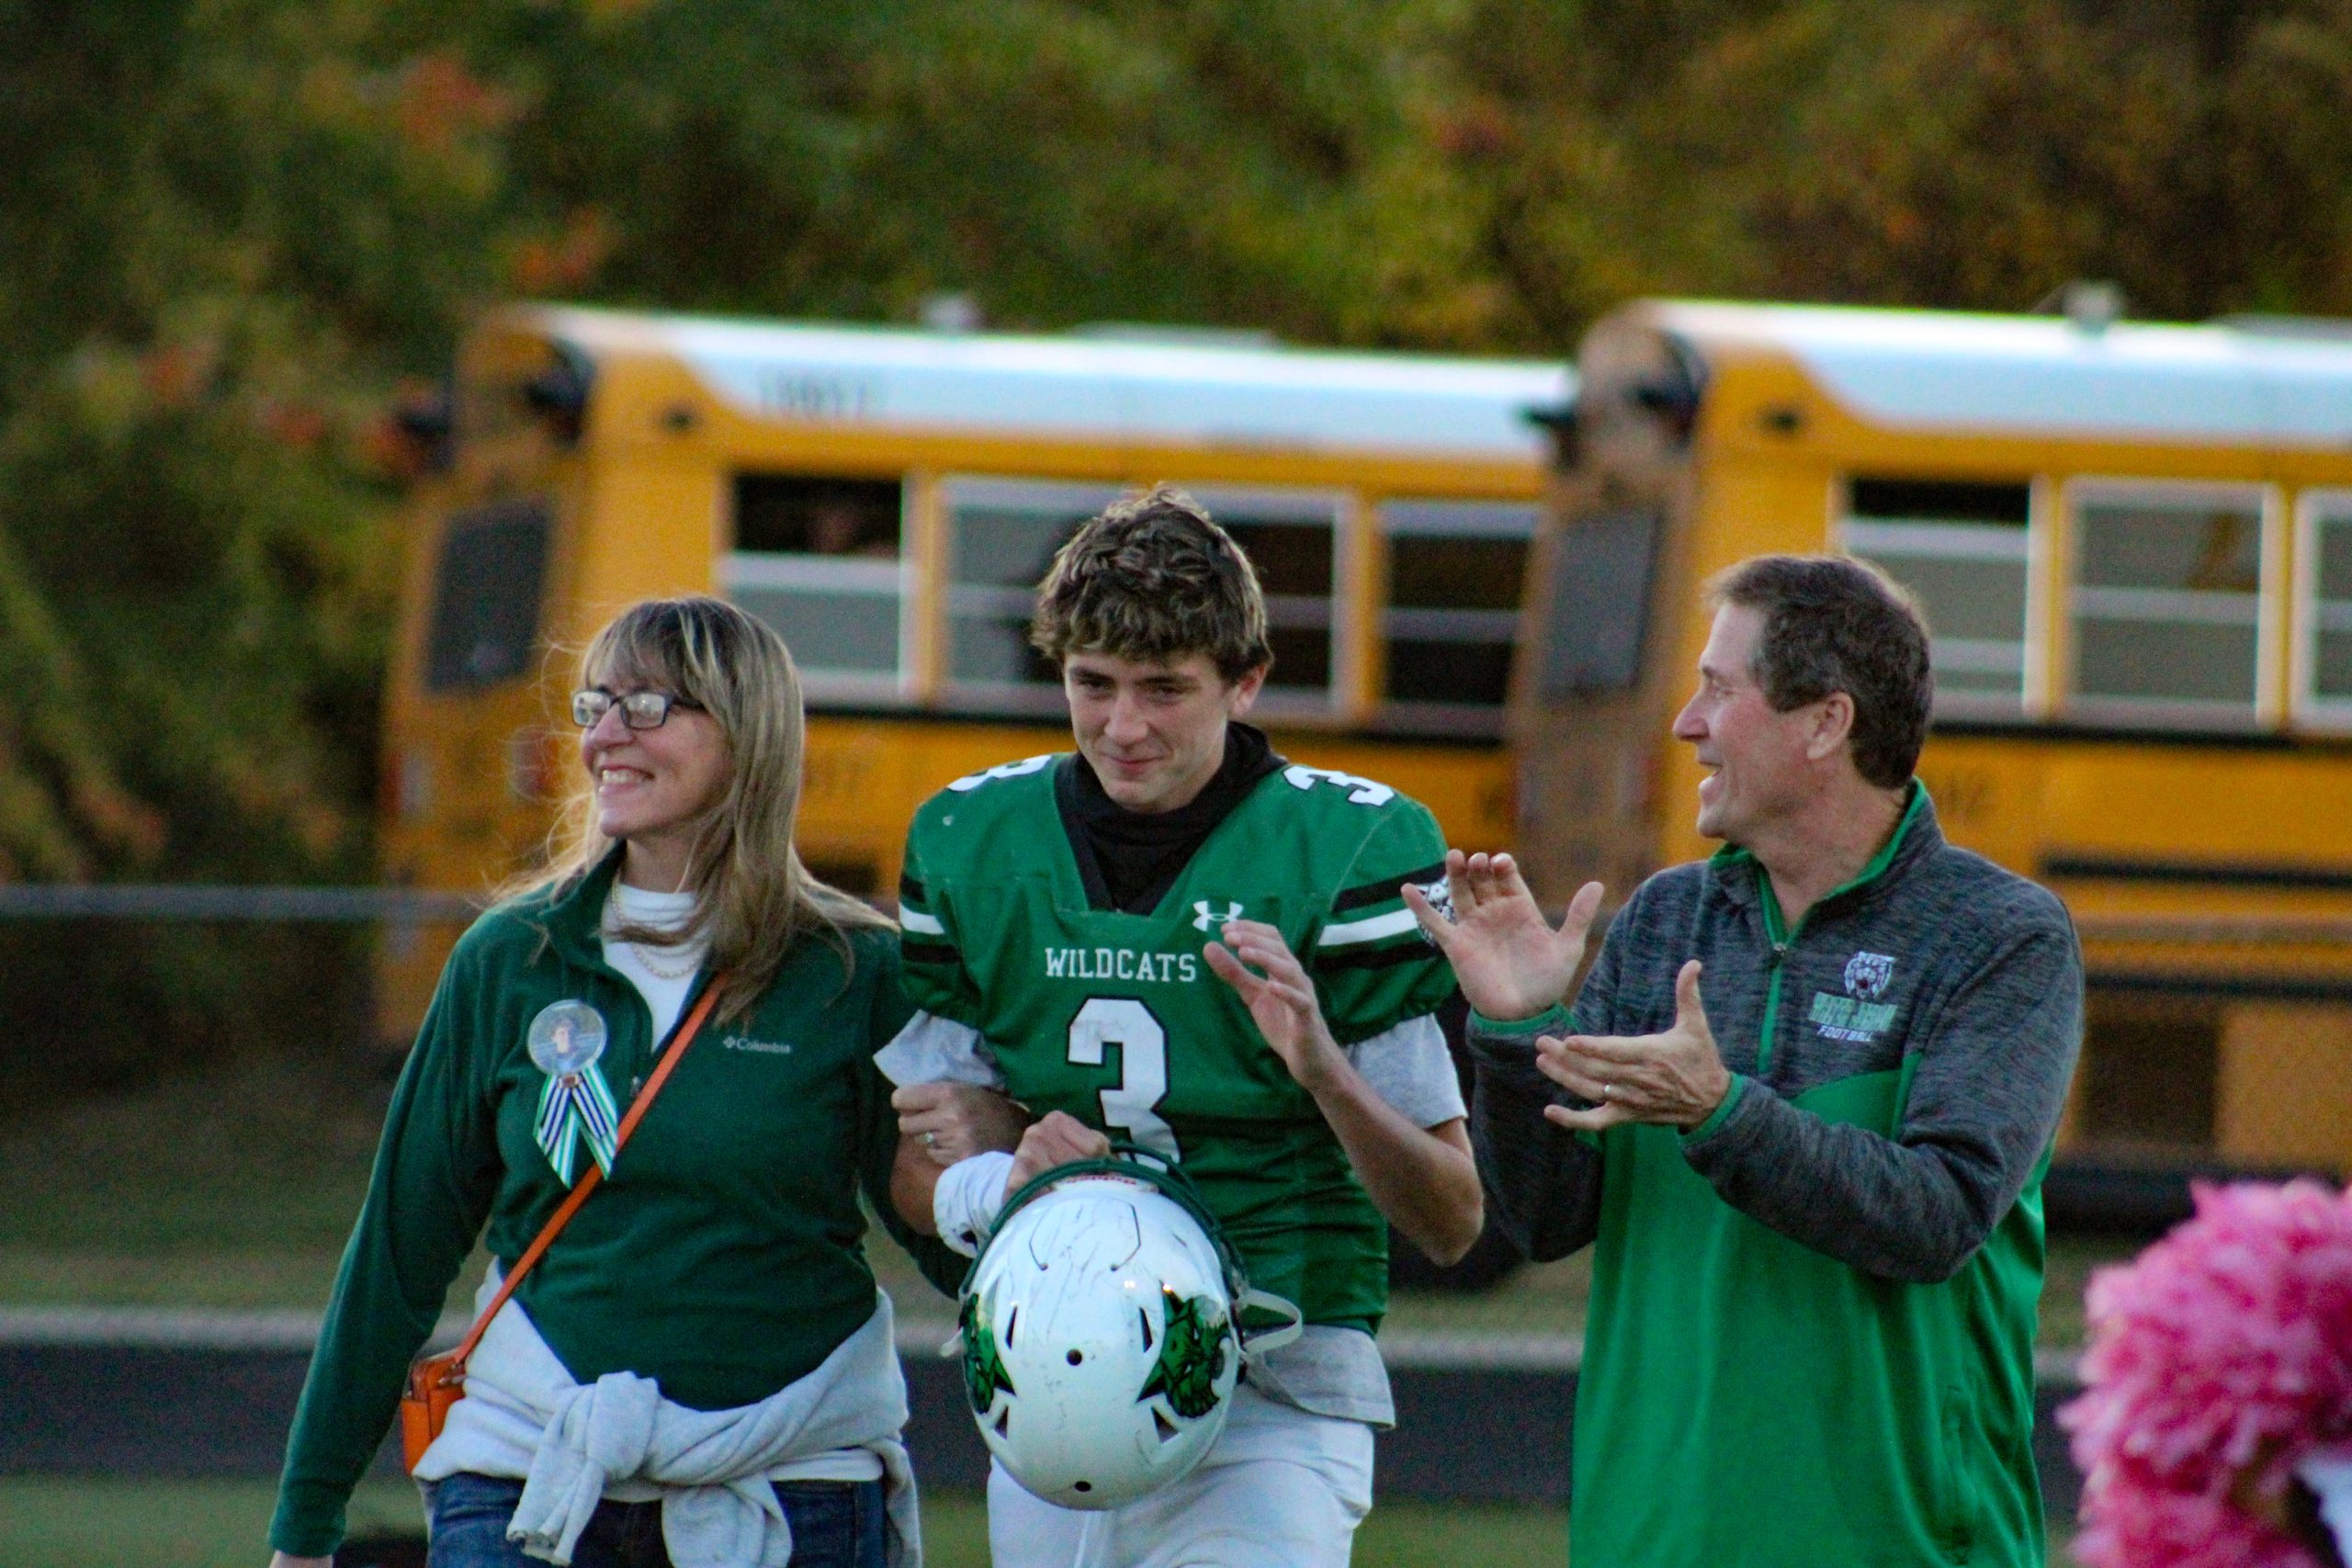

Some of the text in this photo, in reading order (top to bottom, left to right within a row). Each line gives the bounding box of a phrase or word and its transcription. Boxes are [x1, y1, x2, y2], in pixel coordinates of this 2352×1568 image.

[1283, 764, 1396, 807] 3
[1045, 947, 1196, 982] WILDCATS
[737, 1037, 791, 1054] Columbia
[1067, 995, 1182, 1173] 3
